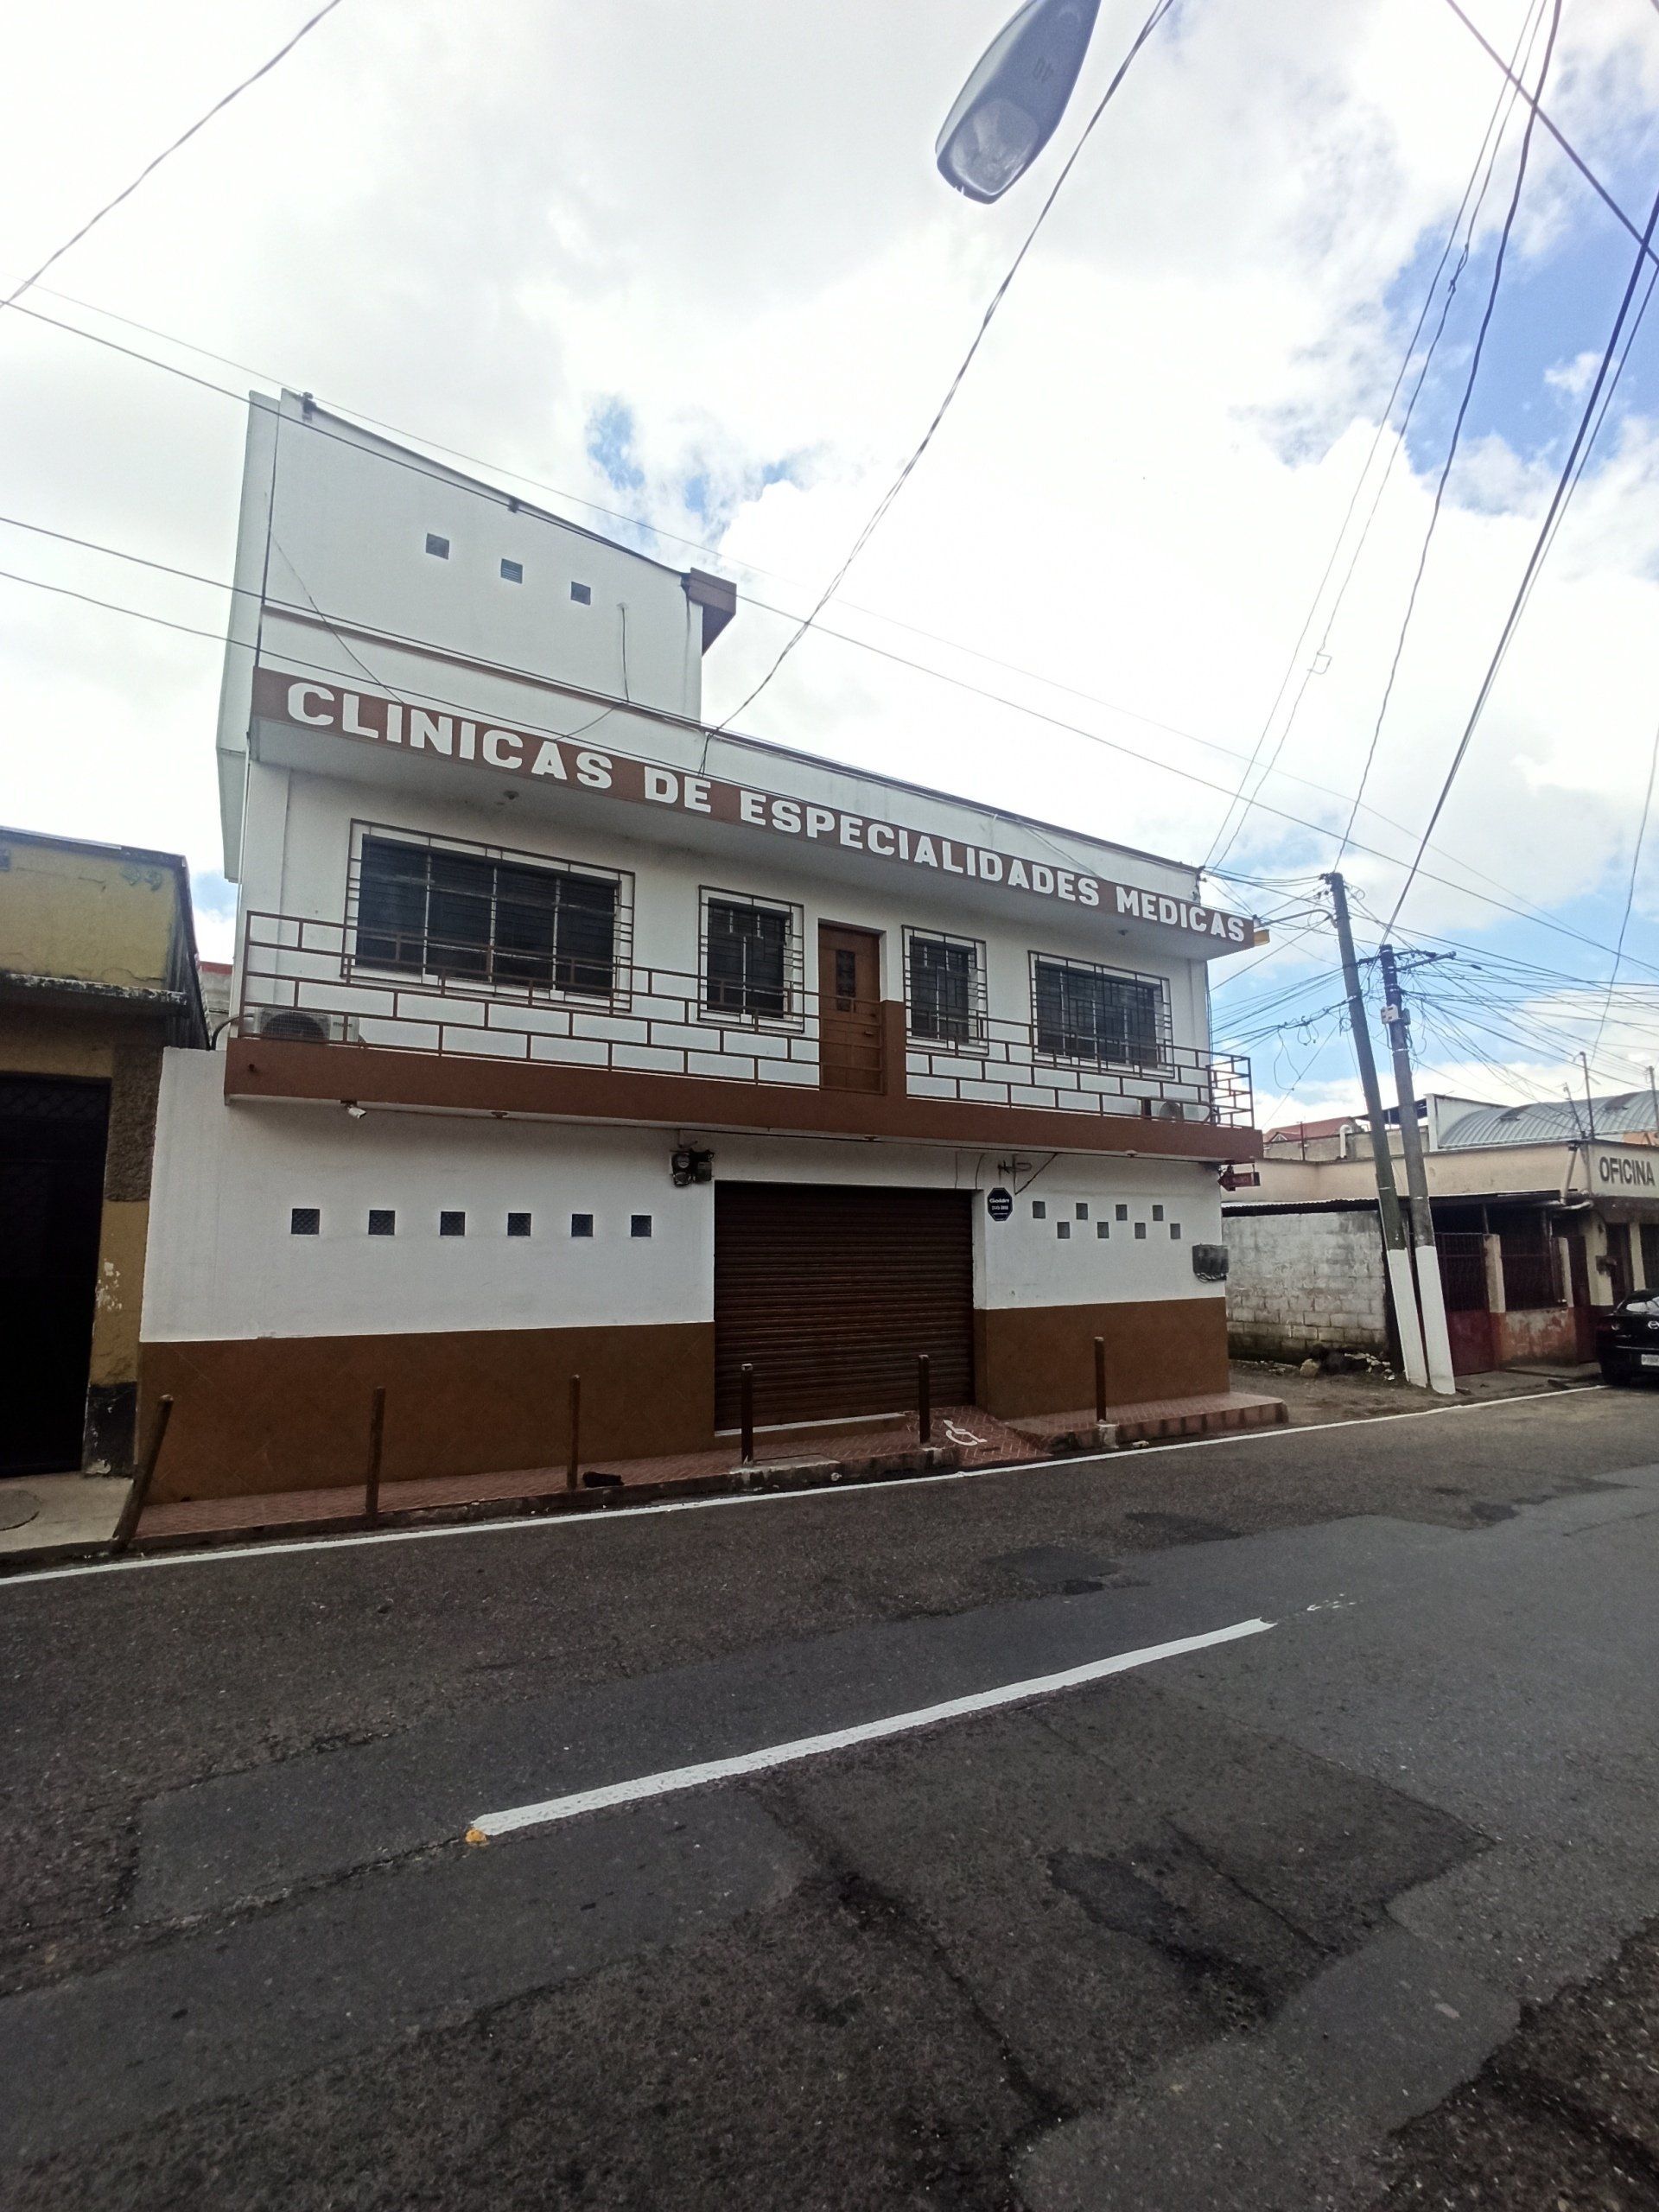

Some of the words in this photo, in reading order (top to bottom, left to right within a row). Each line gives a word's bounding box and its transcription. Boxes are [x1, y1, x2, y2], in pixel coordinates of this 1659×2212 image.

[287, 682, 613, 789] CLINICAS
[644, 766, 711, 813] DE
[740, 790, 1100, 906] ESPECIALIDADES
[1116, 886, 1245, 942] MEDICAS
[1599, 1156, 1656, 1186] OFICINA
